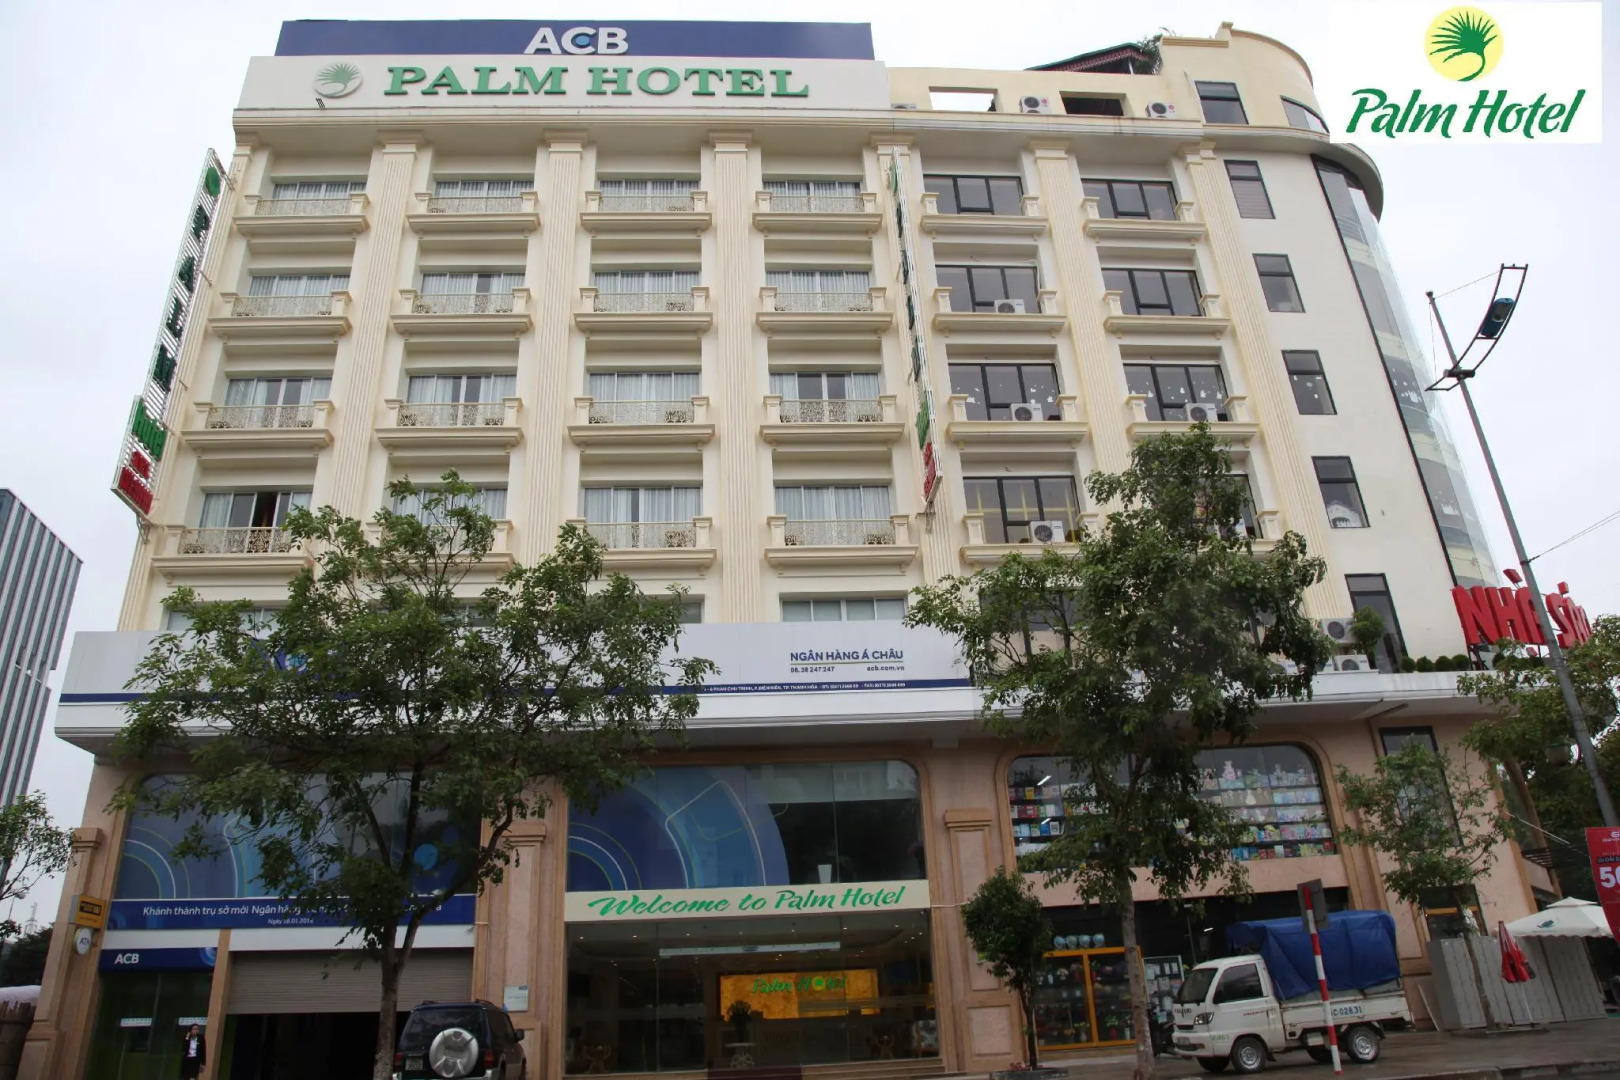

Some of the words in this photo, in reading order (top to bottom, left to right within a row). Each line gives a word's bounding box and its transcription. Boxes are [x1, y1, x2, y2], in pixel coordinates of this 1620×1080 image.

[524, 27, 629, 55] ACB
[384, 66, 567, 95] PALM
[585, 66, 810, 98] HOTEL
[790, 649, 823, 661] NGÂN
[826, 649, 860, 661] HÀNG
[861, 648, 870, 660] Á
[871, 648, 904, 660] CHÂU
[143, 906, 172, 916] Khánh
[174, 906, 201, 916] thành
[202, 906, 216, 917] trụ
[231, 905, 249, 914] mới
[251, 905, 277, 916] Ngân
[588, 894, 731, 917] Welcome
[738, 893, 767, 911] to
[775, 889, 835, 910] Palm
[840, 885, 906, 907] Hotel
[114, 953, 140, 965] ACB
